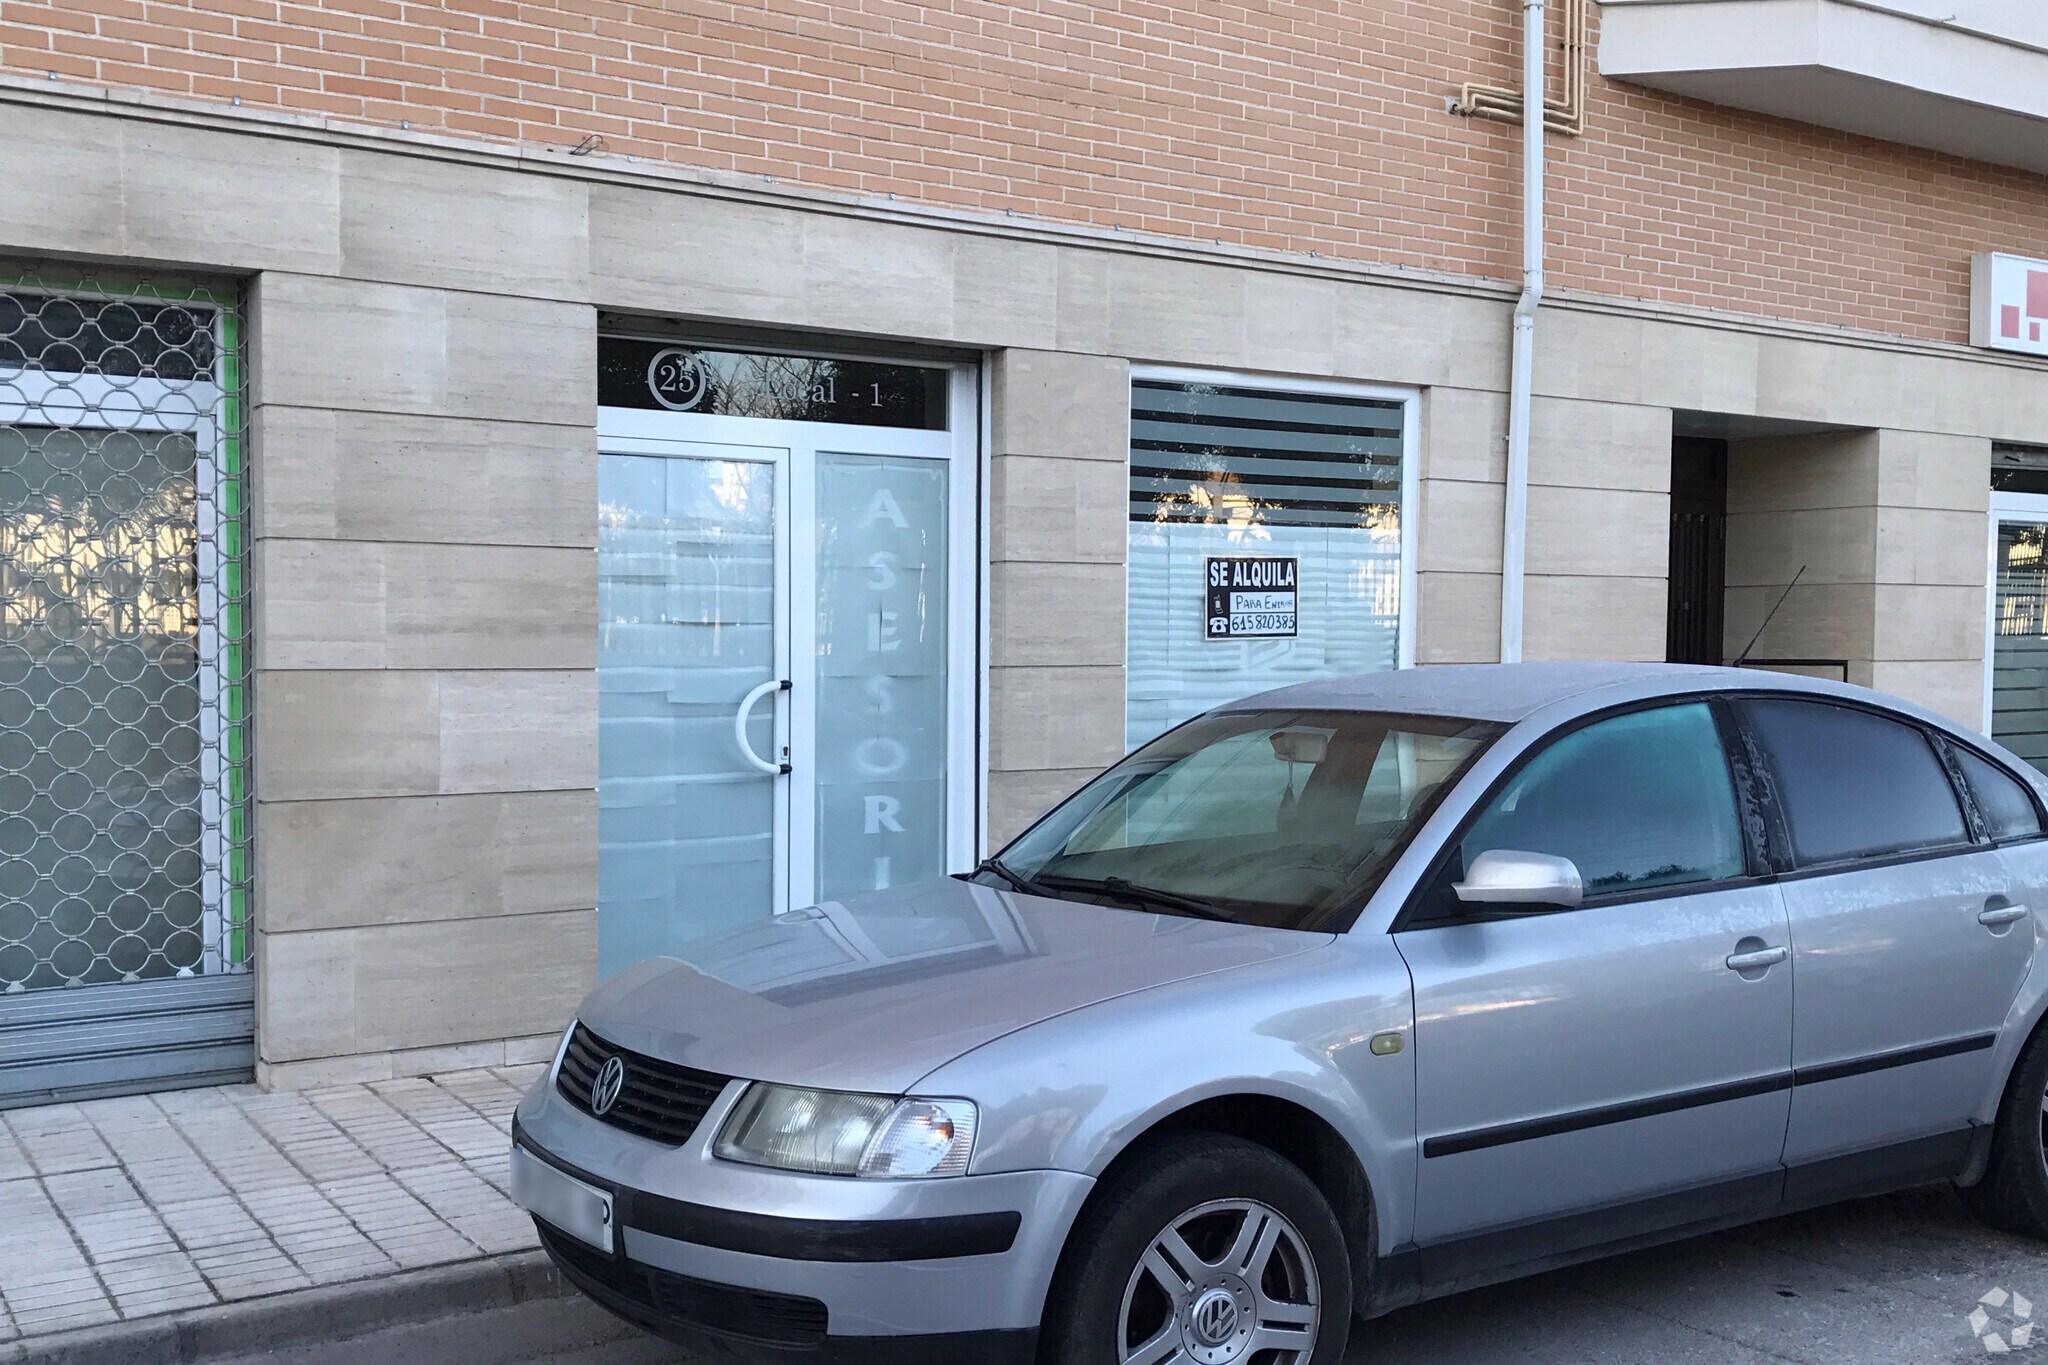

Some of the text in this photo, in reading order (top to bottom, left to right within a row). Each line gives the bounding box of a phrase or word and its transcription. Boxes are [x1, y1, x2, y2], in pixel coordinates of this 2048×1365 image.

[659, 364, 695, 393] 25
[764, 371, 837, 404] Local
[869, 381, 883, 407] 1
[1210, 561, 1295, 588] SE ALQUILA
